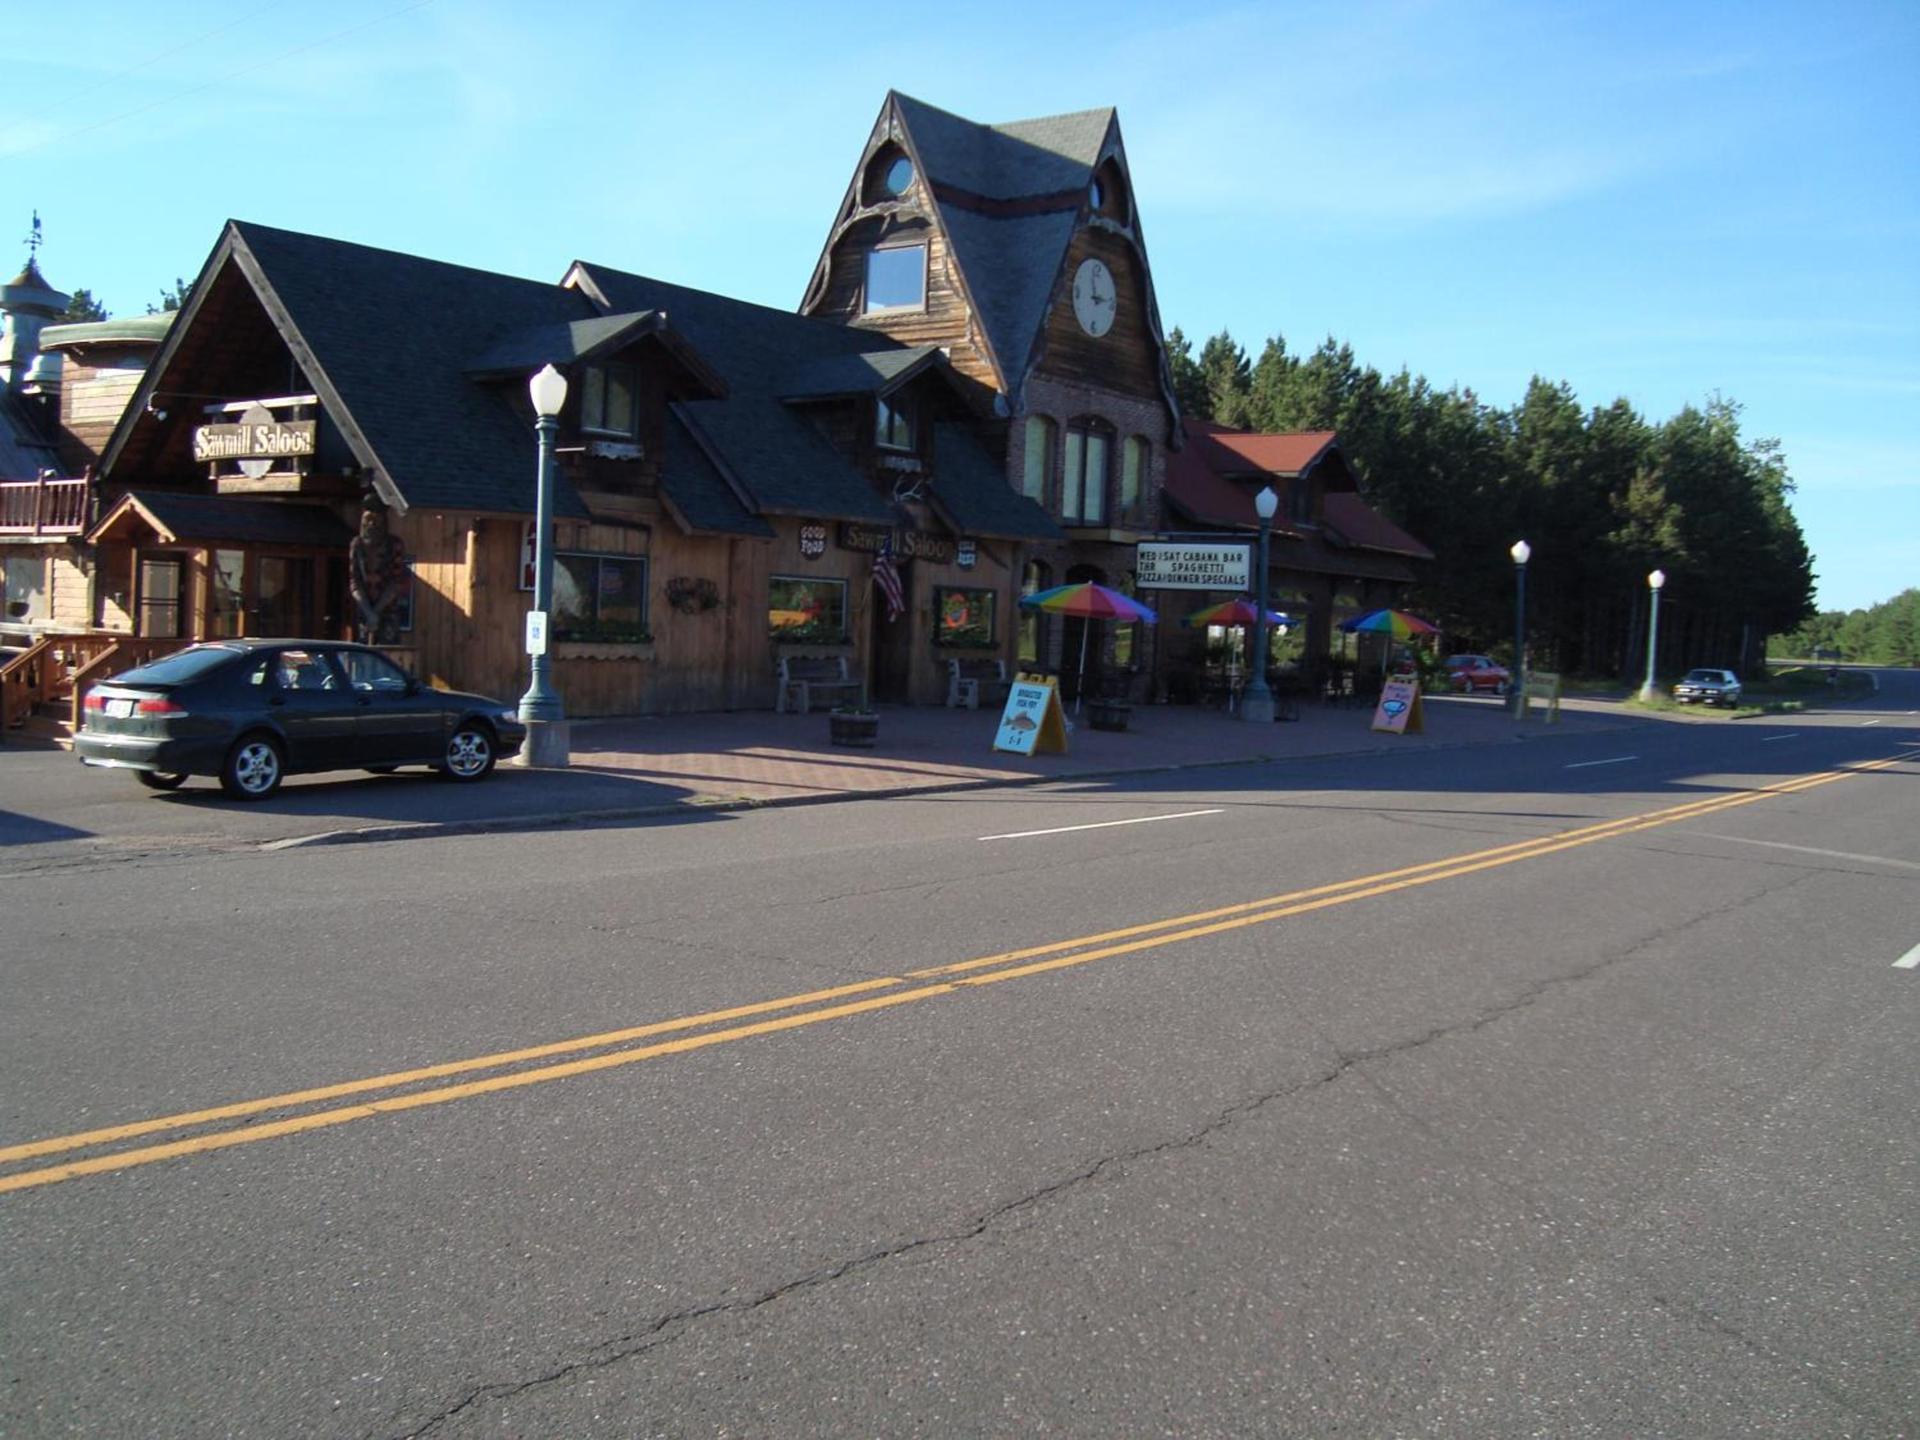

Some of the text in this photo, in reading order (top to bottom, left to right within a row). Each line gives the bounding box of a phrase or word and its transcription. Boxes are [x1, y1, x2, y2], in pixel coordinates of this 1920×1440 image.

[194, 424, 311, 458] Sawmill Saloon
[847, 526, 900, 553] Sawmll
[1183, 552, 1218, 562] CABANA
[1223, 553, 1243, 562] BAR
[1171, 563, 1225, 573] SPAGHETTI
[1201, 574, 1246, 585] SPECIALS
